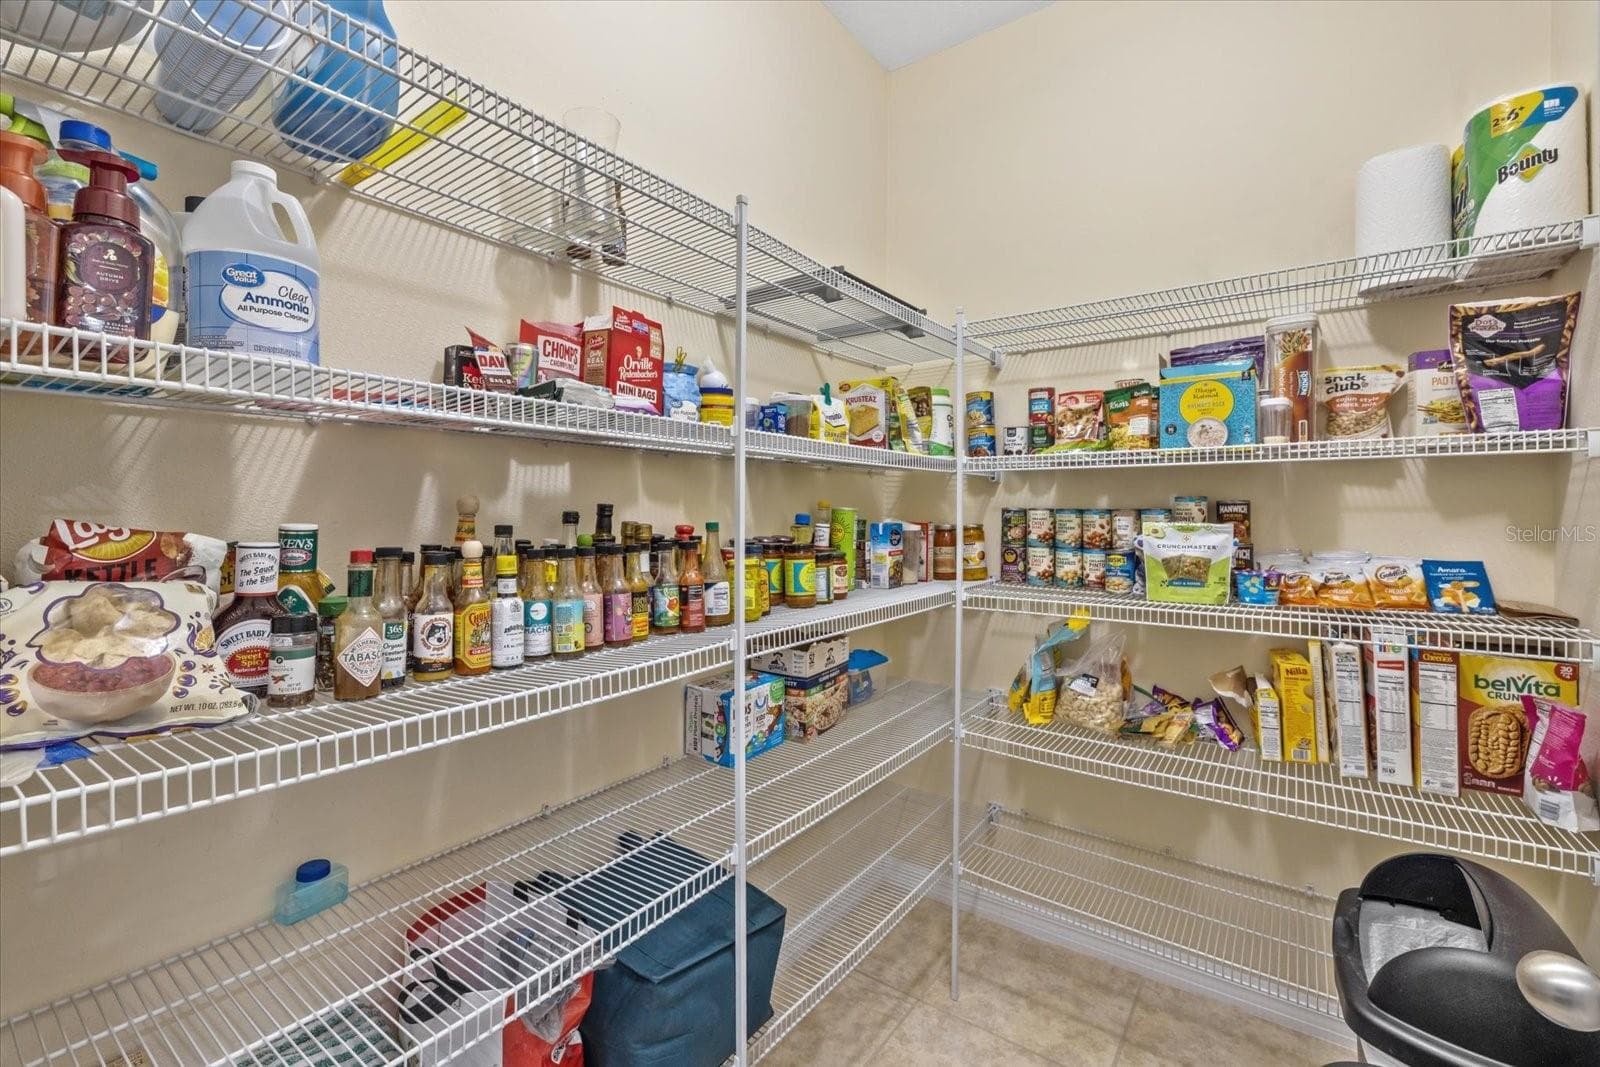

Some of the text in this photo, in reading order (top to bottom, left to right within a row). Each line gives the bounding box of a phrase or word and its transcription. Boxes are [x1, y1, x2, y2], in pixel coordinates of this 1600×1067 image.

[1498, 147, 1559, 185] Bounty
[226, 267, 257, 280] Great
[278, 285, 309, 303] Clear
[242, 291, 309, 315] Ammonia
[237, 304, 310, 323] All Purpose Cleaner
[542, 339, 578, 365] CHOMPS
[623, 354, 653, 371] Orville
[1324, 372, 1366, 384] snak
[1431, 376, 1449, 386] PAD
[618, 382, 656, 401] MINI BAGS
[1325, 382, 1362, 395] club
[845, 395, 877, 406] KRUSTEAZ
[279, 537, 314, 550] KEN'S
[1156, 543, 1218, 551] CRUNCHMASTER
[64, 558, 157, 583] KETTLE
[240, 565, 274, 577] The Sauce
[1379, 567, 1408, 580] Goldfish
[239, 578, 245, 587] is
[246, 577, 258, 586] the
[387, 625, 403, 634] 365
[220, 629, 267, 650] SWEET BABY
[235, 652, 261, 661] Sweet
[240, 658, 266, 668] Spicy
[1285, 667, 1308, 677] Nilla
[1473, 672, 1561, 698] belVita
[1487, 691, 1522, 702] CRUN
[169, 705, 183, 714] NET
[198, 703, 207, 711] 10
